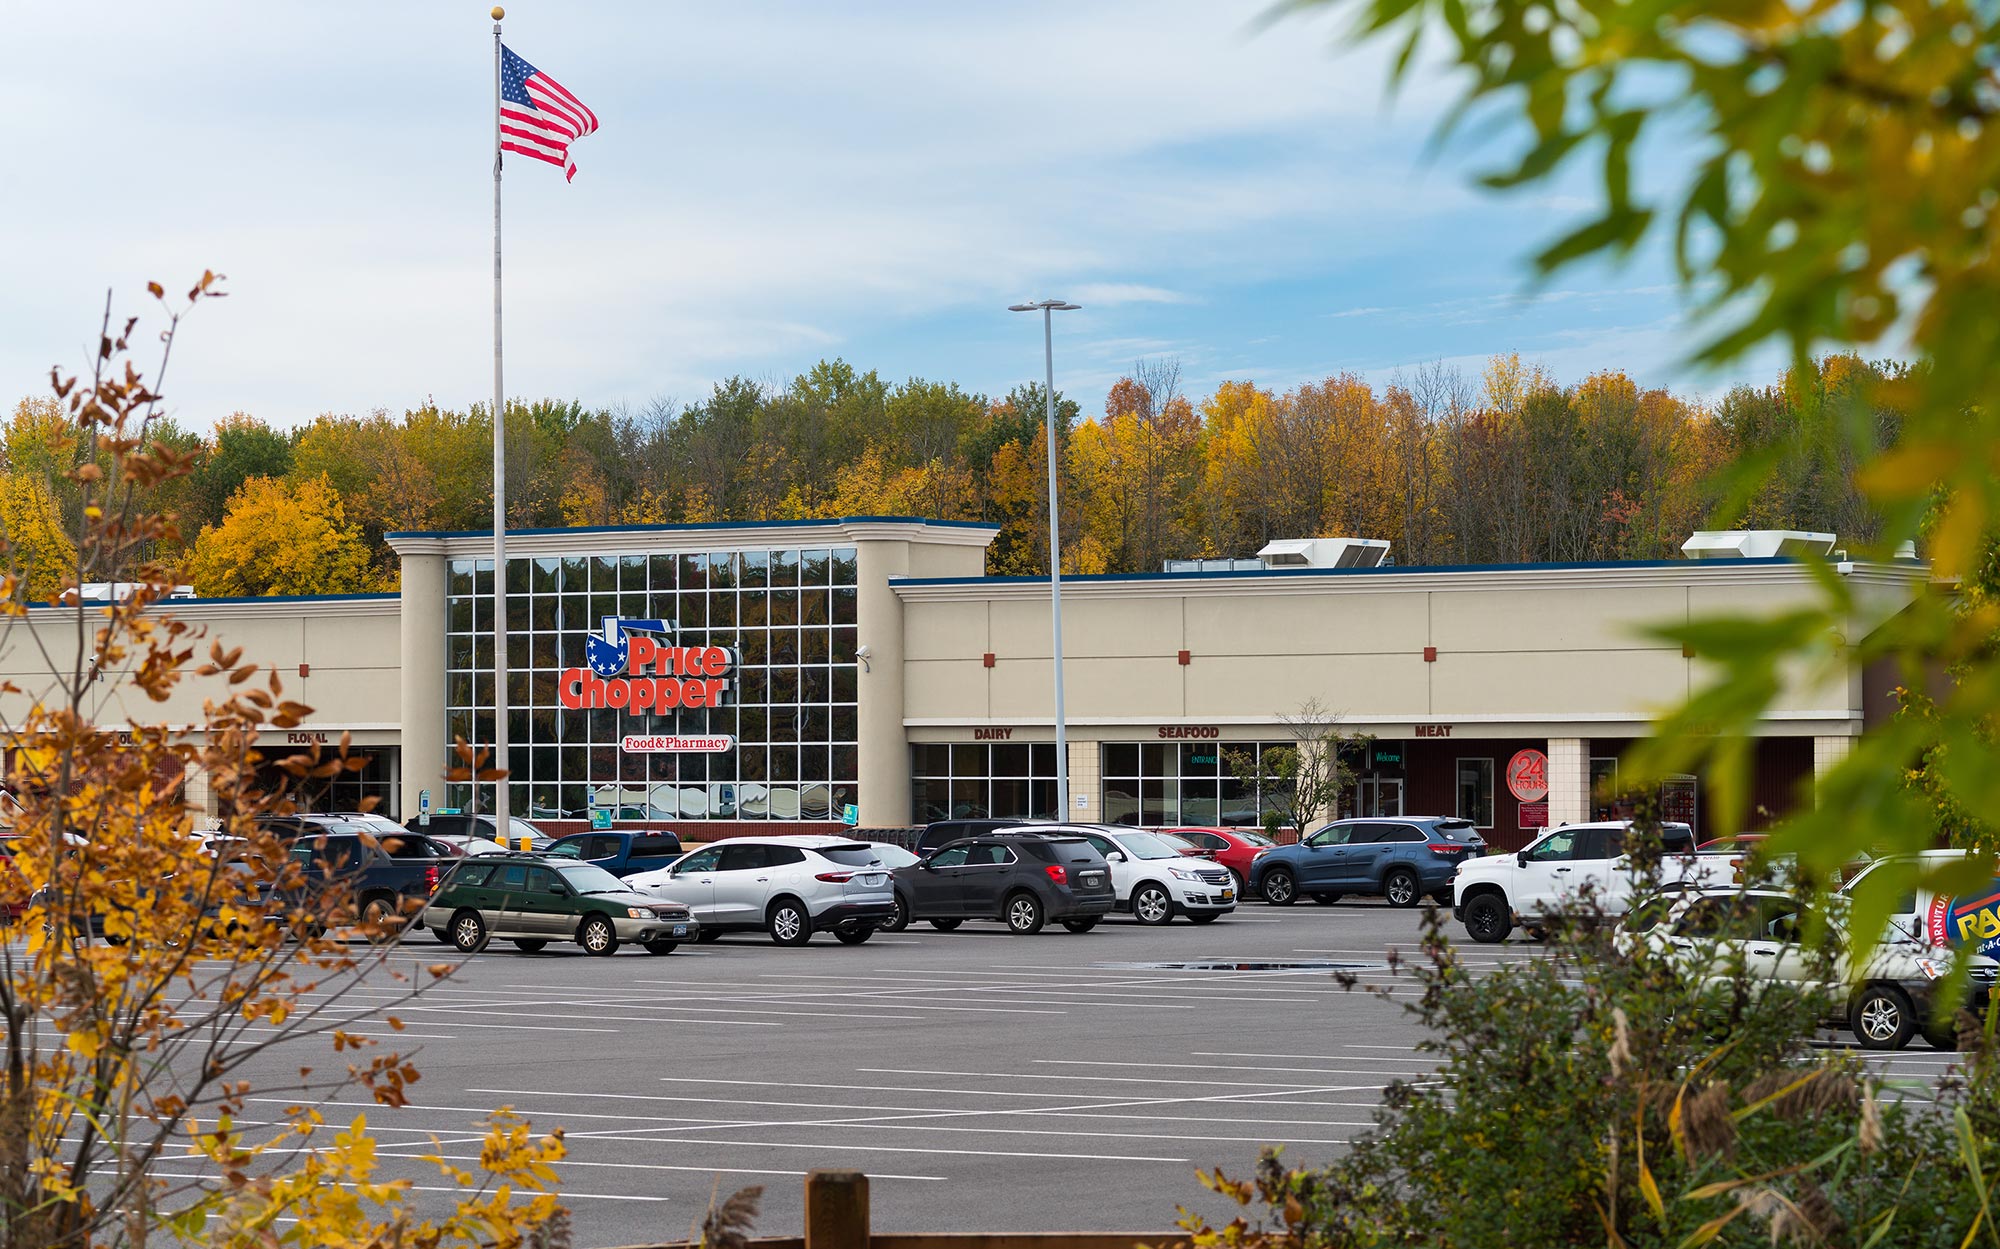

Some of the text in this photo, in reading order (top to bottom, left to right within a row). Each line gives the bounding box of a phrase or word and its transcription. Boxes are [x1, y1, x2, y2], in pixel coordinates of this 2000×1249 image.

[628, 637, 728, 677] Price
[559, 667, 725, 716] Chopper
[974, 728, 1012, 740] DAIRY
[1158, 727, 1219, 739] SEAFOOD
[1415, 725, 1452, 737] MEAT
[287, 733, 328, 744] FLORAL
[625, 737, 728, 752] Food&Pharmacy
[1191, 755, 1217, 764] ENTRANC
[1376, 752, 1400, 763] Welcome
[1516, 755, 1545, 780] 24
[1515, 780, 1548, 790] HOURS
[1934, 893, 1949, 948] URNITUR
[1956, 904, 2000, 942] RA
